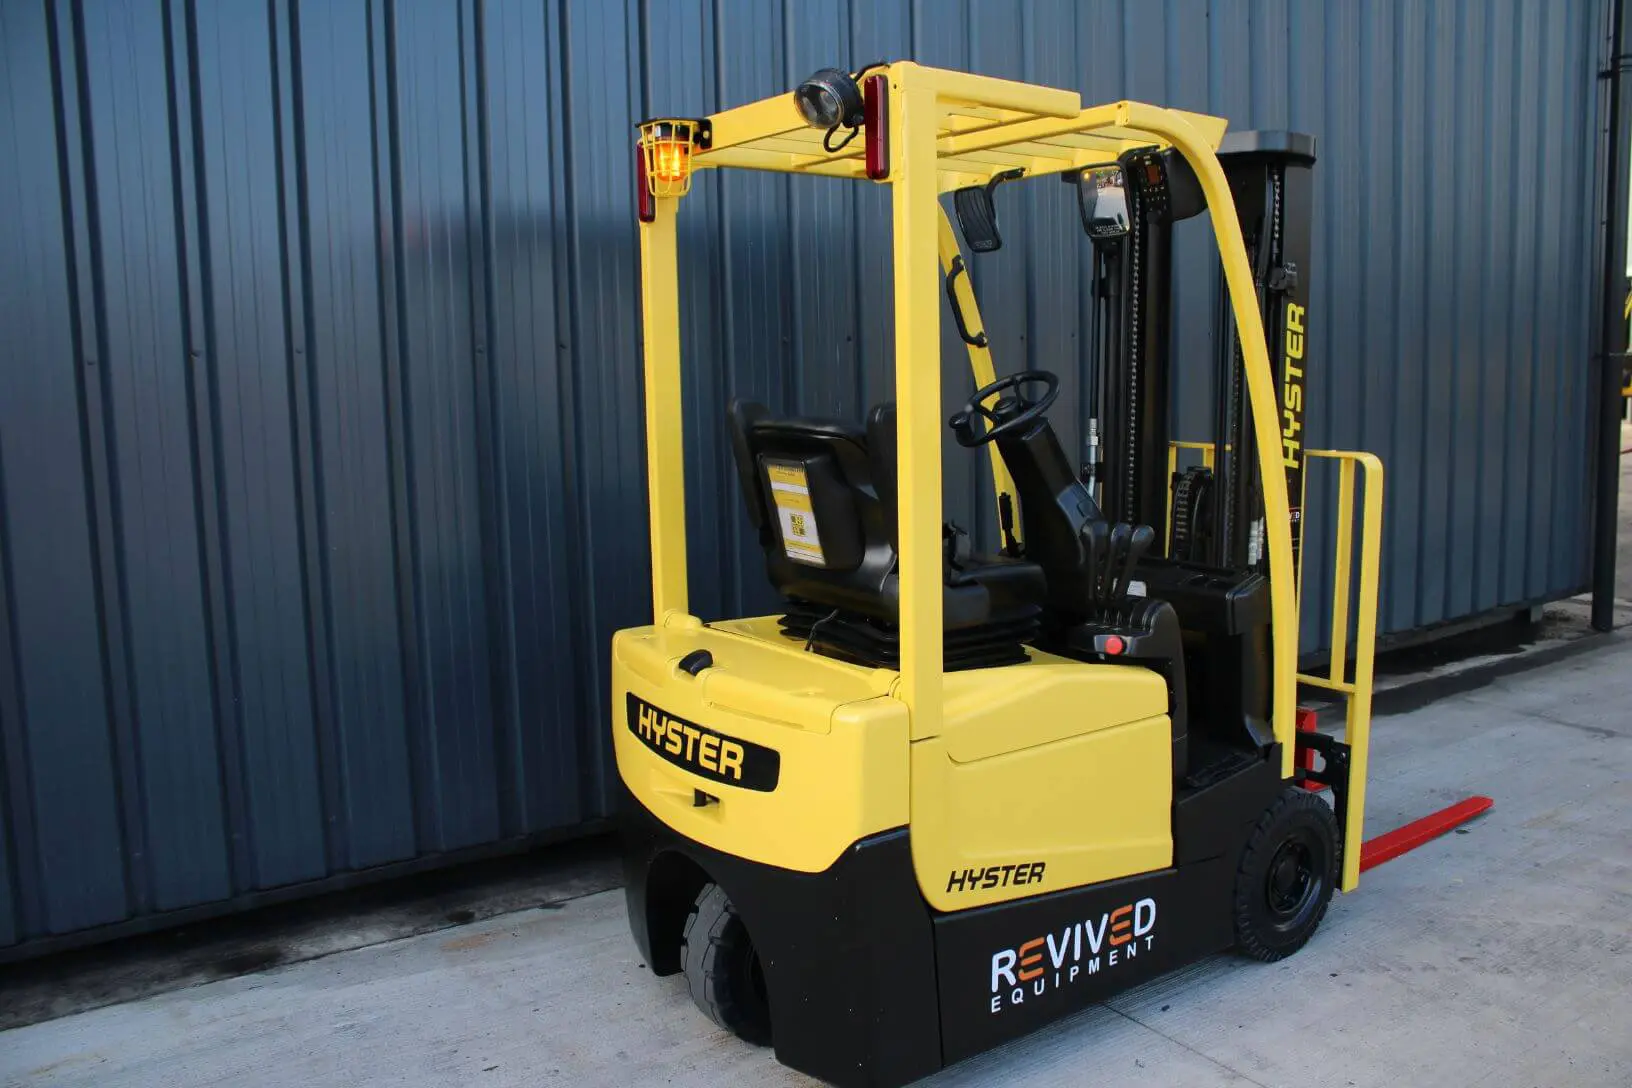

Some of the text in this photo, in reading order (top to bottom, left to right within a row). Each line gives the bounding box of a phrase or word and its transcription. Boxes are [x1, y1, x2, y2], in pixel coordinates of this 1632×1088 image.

[1283, 302, 1305, 469] HYSTER
[638, 703, 745, 780] HYSTER
[946, 862, 1046, 893] HYSTER
[991, 898, 1156, 993] REVIVED
[991, 935, 1154, 1013] EQUIPMENT
